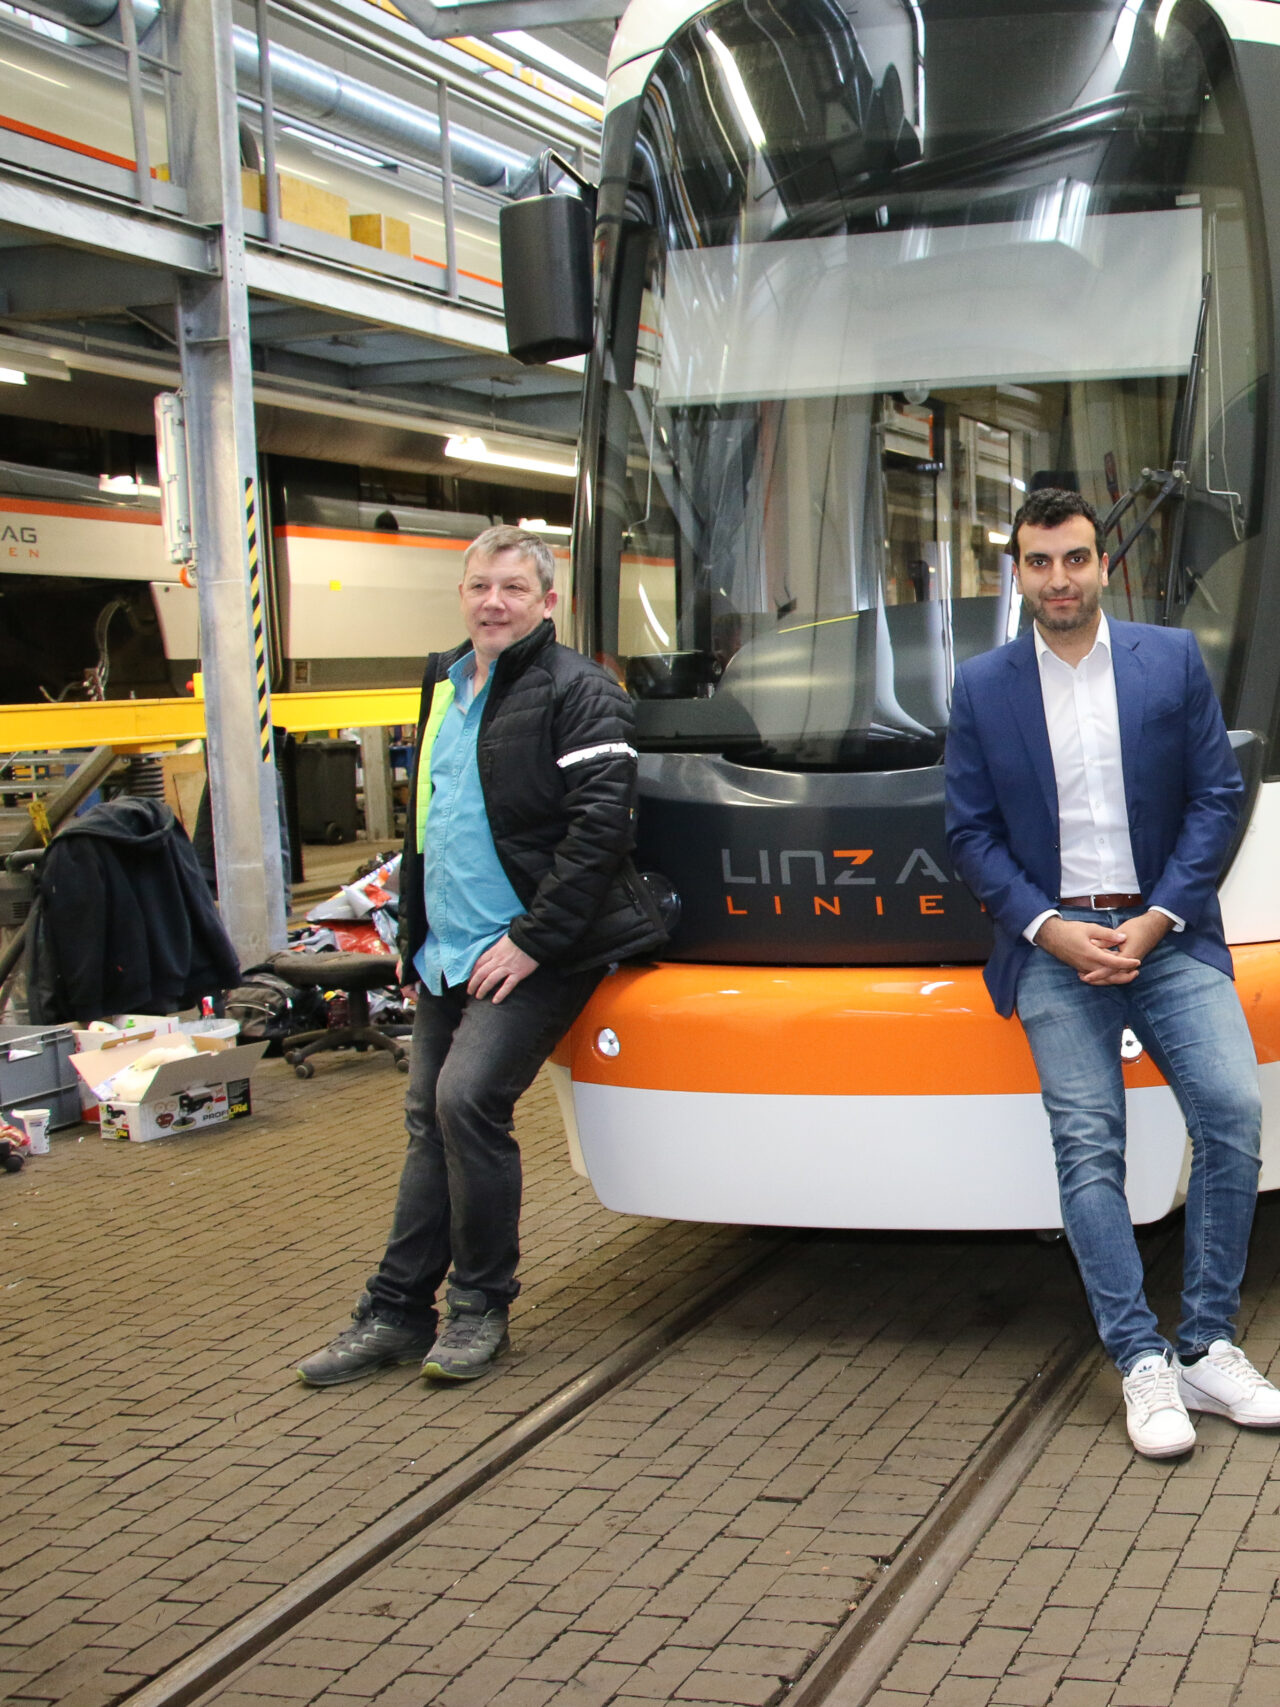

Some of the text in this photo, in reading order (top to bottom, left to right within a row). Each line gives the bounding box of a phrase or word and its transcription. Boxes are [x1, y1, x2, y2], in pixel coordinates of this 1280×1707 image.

[1, 525, 37, 543] AG
[721, 848, 963, 885] LINZ A
[726, 895, 986, 915] LINIE
